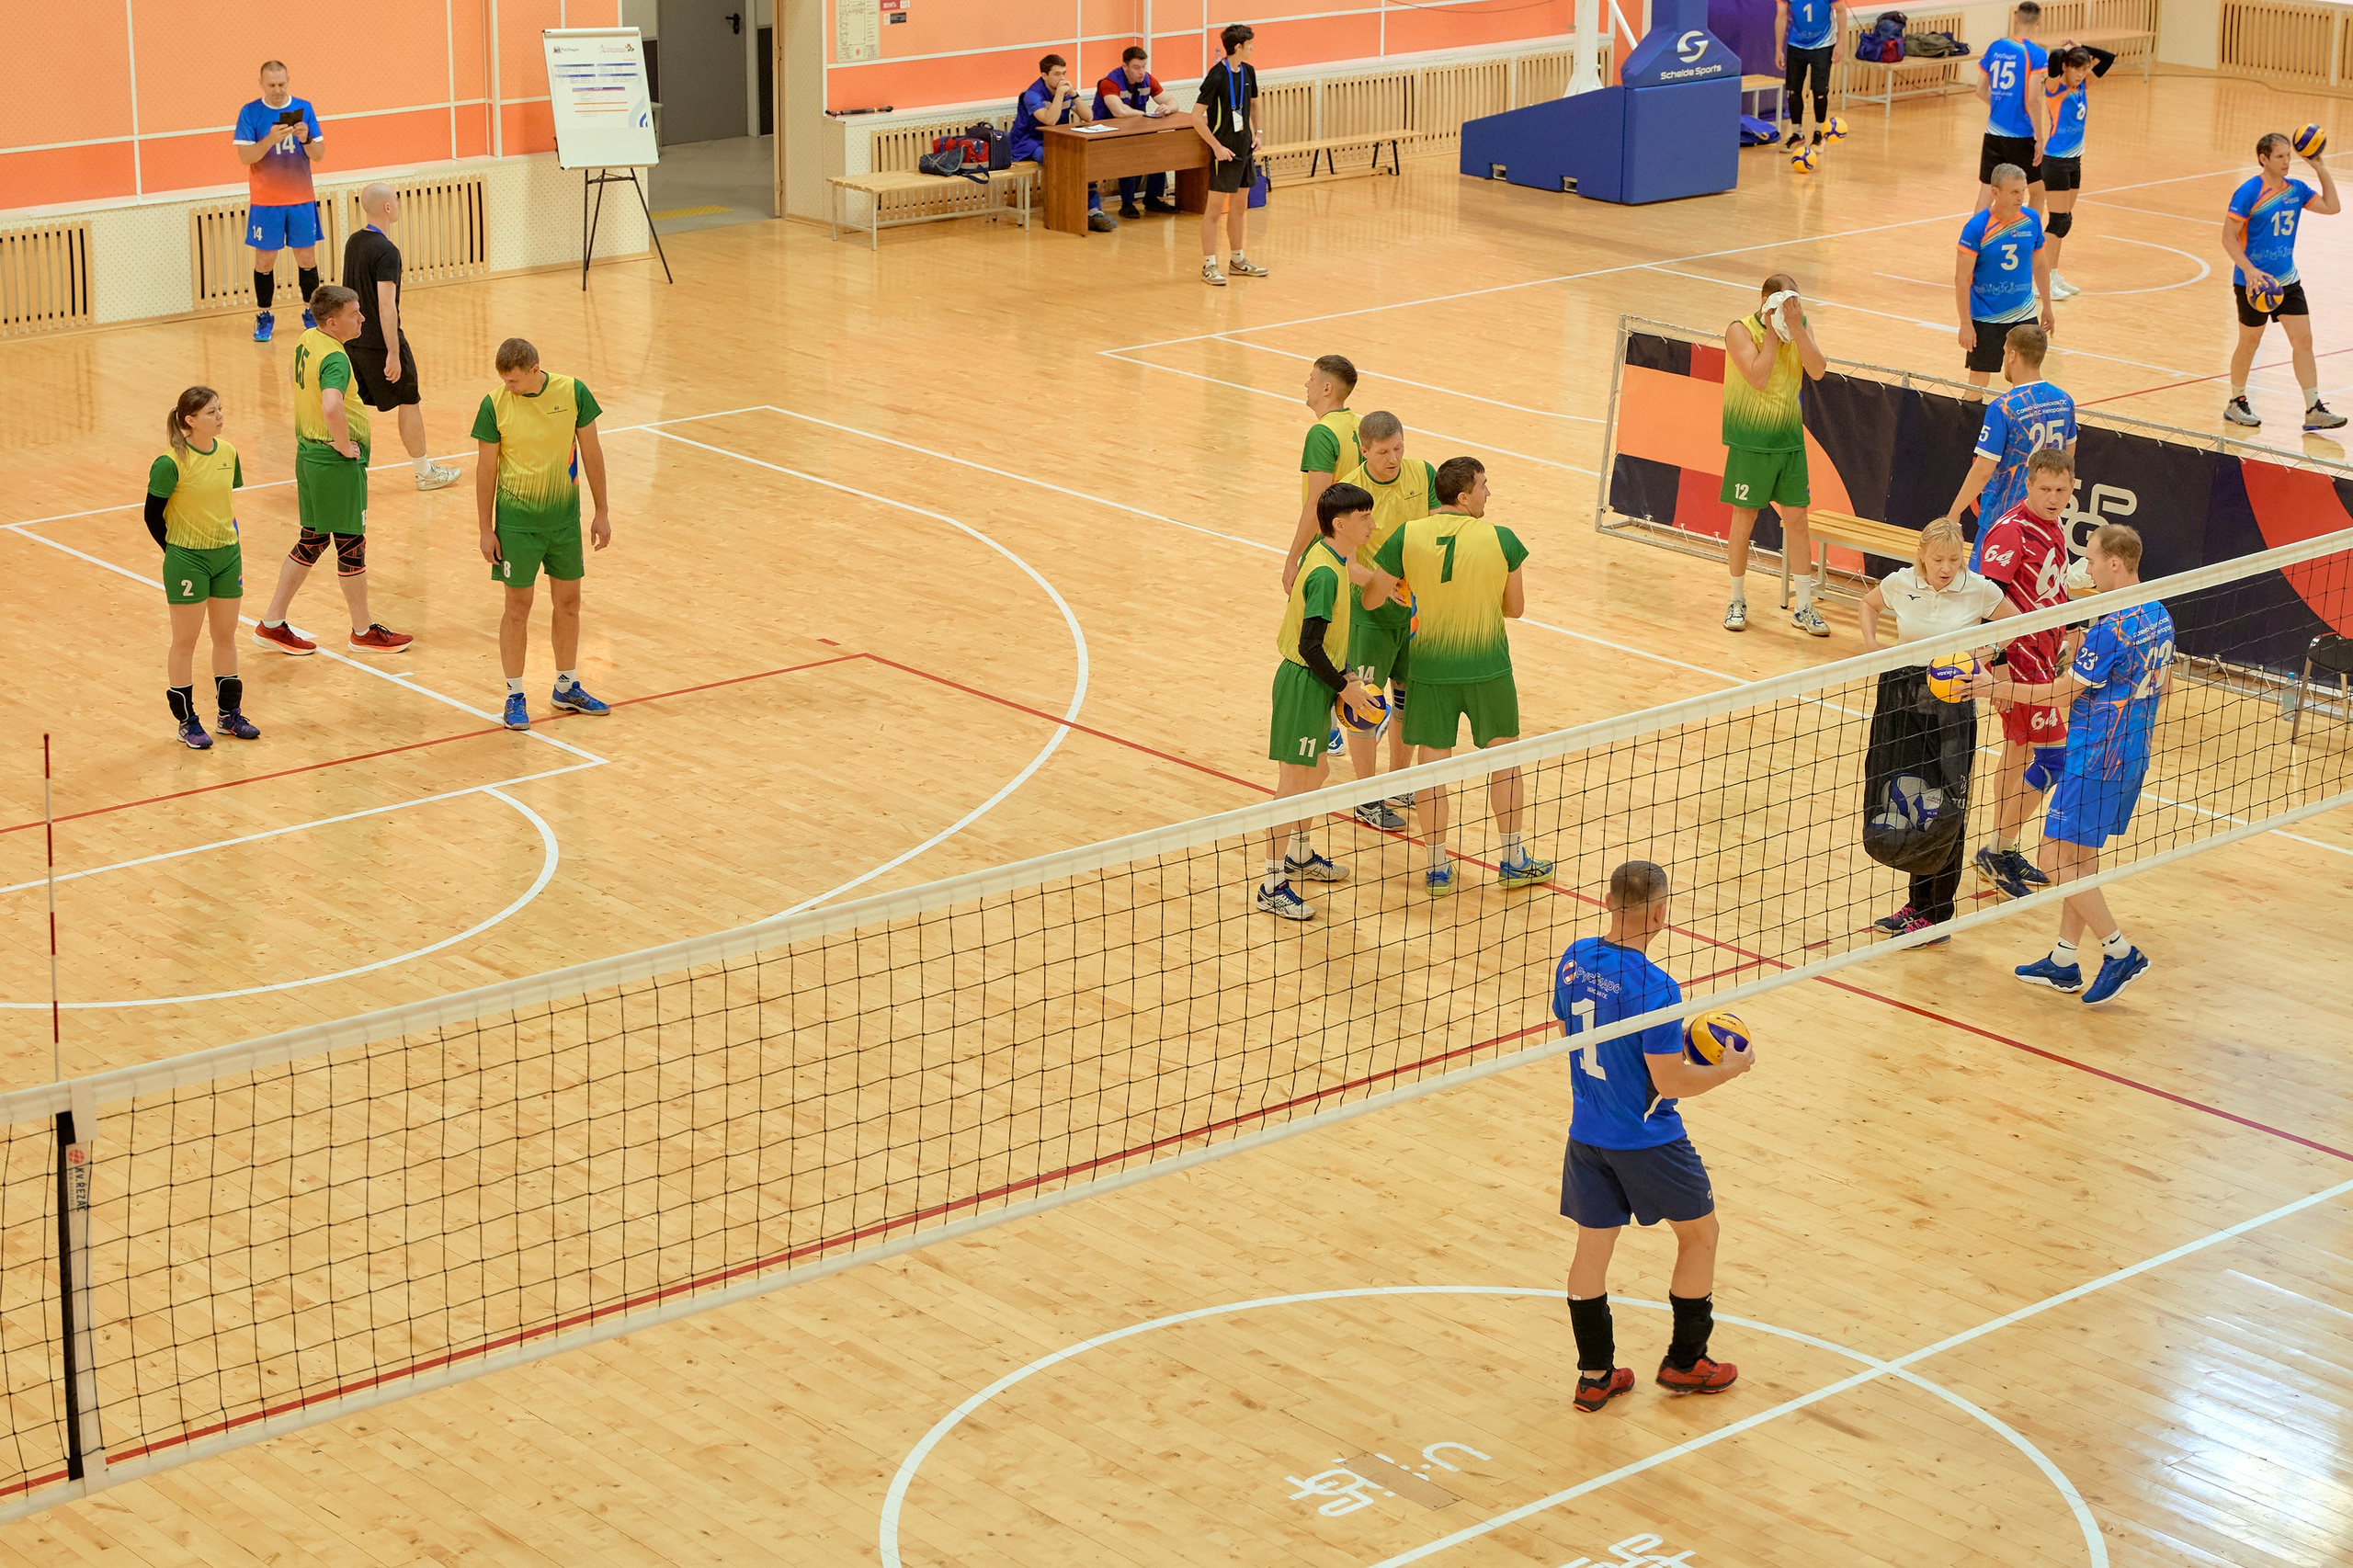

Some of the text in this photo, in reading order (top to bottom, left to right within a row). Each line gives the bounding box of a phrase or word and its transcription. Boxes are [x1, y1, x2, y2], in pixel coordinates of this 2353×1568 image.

[1802, 4, 1813, 22] 1
[1695, 64, 1722, 76] Sports
[1989, 60, 2017, 90] 15
[252, 224, 263, 242] 14
[2270, 210, 2296, 237] 13
[2000, 244, 2019, 271] 3
[295, 343, 311, 391] 15
[1734, 483, 1750, 501] 12
[1436, 535, 1456, 584] 7
[1984, 544, 2015, 567] 64
[503, 561, 511, 578] 8
[181, 579, 194, 597] 2
[2075, 647, 2098, 671] 23
[2135, 639, 2173, 699] 23
[1357, 665, 1375, 683] 14
[2030, 707, 2059, 732] 64
[1299, 736, 1317, 757] 11
[1571, 997, 1606, 1081] 1
